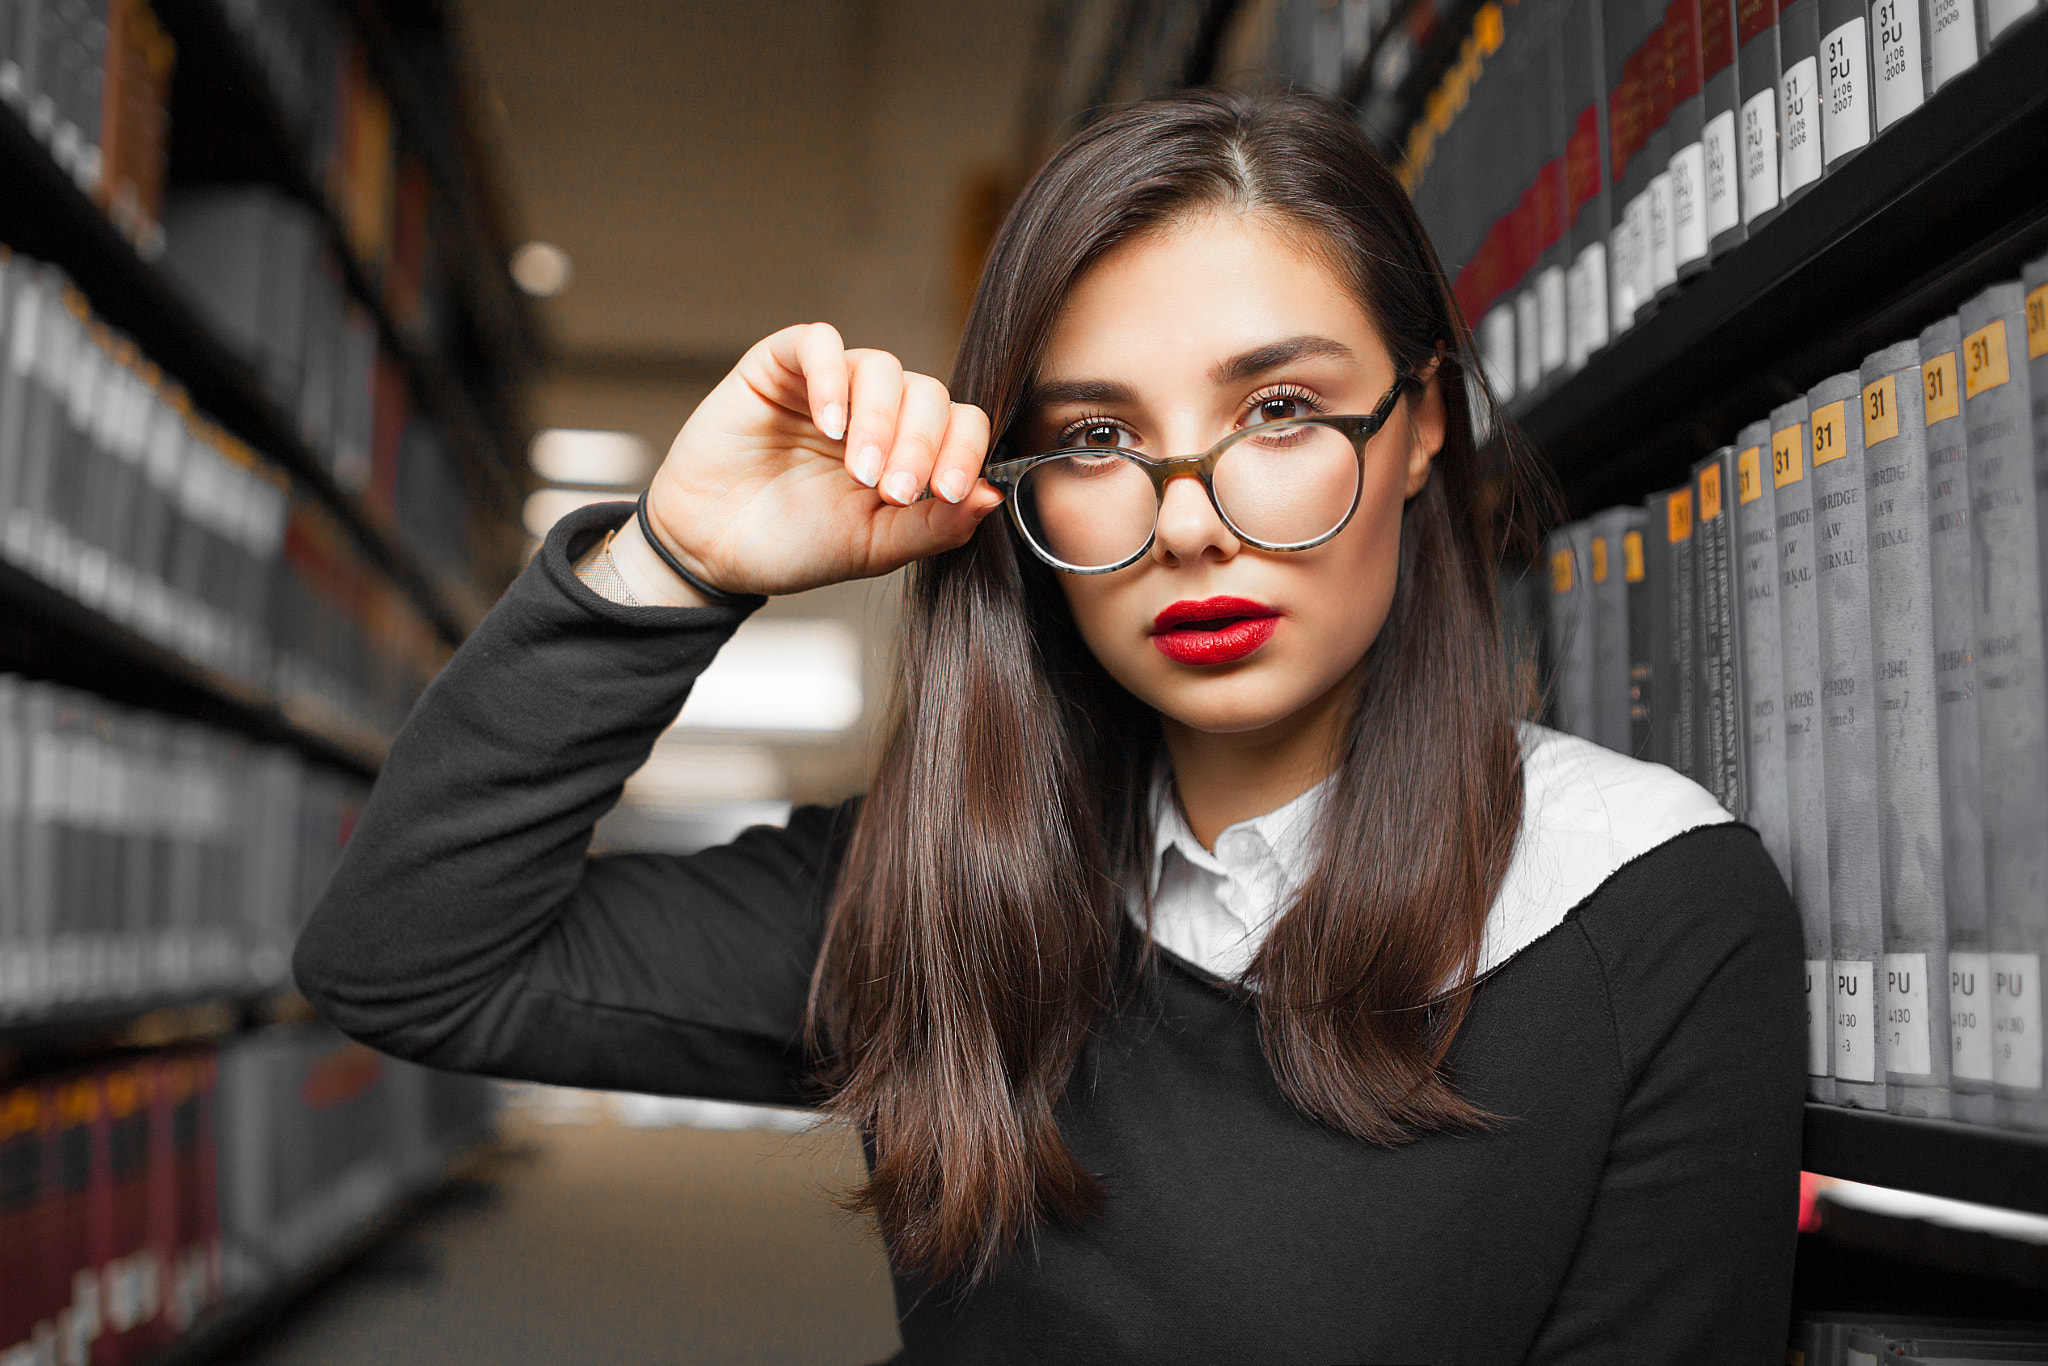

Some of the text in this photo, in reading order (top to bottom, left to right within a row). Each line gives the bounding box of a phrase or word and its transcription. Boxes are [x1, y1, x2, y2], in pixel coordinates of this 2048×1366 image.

[1881, 0, 1896, 27] 31
[1882, 22, 1903, 51] PU
[1829, 37, 1843, 63] 31
[1885, 45, 1905, 66] 4106
[1830, 58, 1850, 86] PU
[1786, 76, 1798, 101] 31
[1833, 81, 1852, 99] 4106
[1788, 97, 1804, 122] PU
[2029, 298, 2046, 335] 31
[1971, 336, 1990, 372] 31
[1927, 366, 1943, 401] 31
[1870, 387, 1884, 421] 31
[1815, 422, 1832, 451] 31
[1775, 447, 1789, 475] 31
[1804, 715, 1811, 733] 2
[1848, 706, 1855, 725] 3
[1839, 975, 1857, 996] PU
[1888, 971, 1911, 994] PU
[1952, 971, 1975, 996] PU
[1996, 971, 2023, 998] PU
[1838, 1013, 1857, 1028] 4130
[1888, 1008, 1911, 1024] 4130
[1952, 1012, 1977, 1029] 4130
[1996, 1017, 2025, 1034] 4130
[1842, 1039, 1851, 1052] -3
